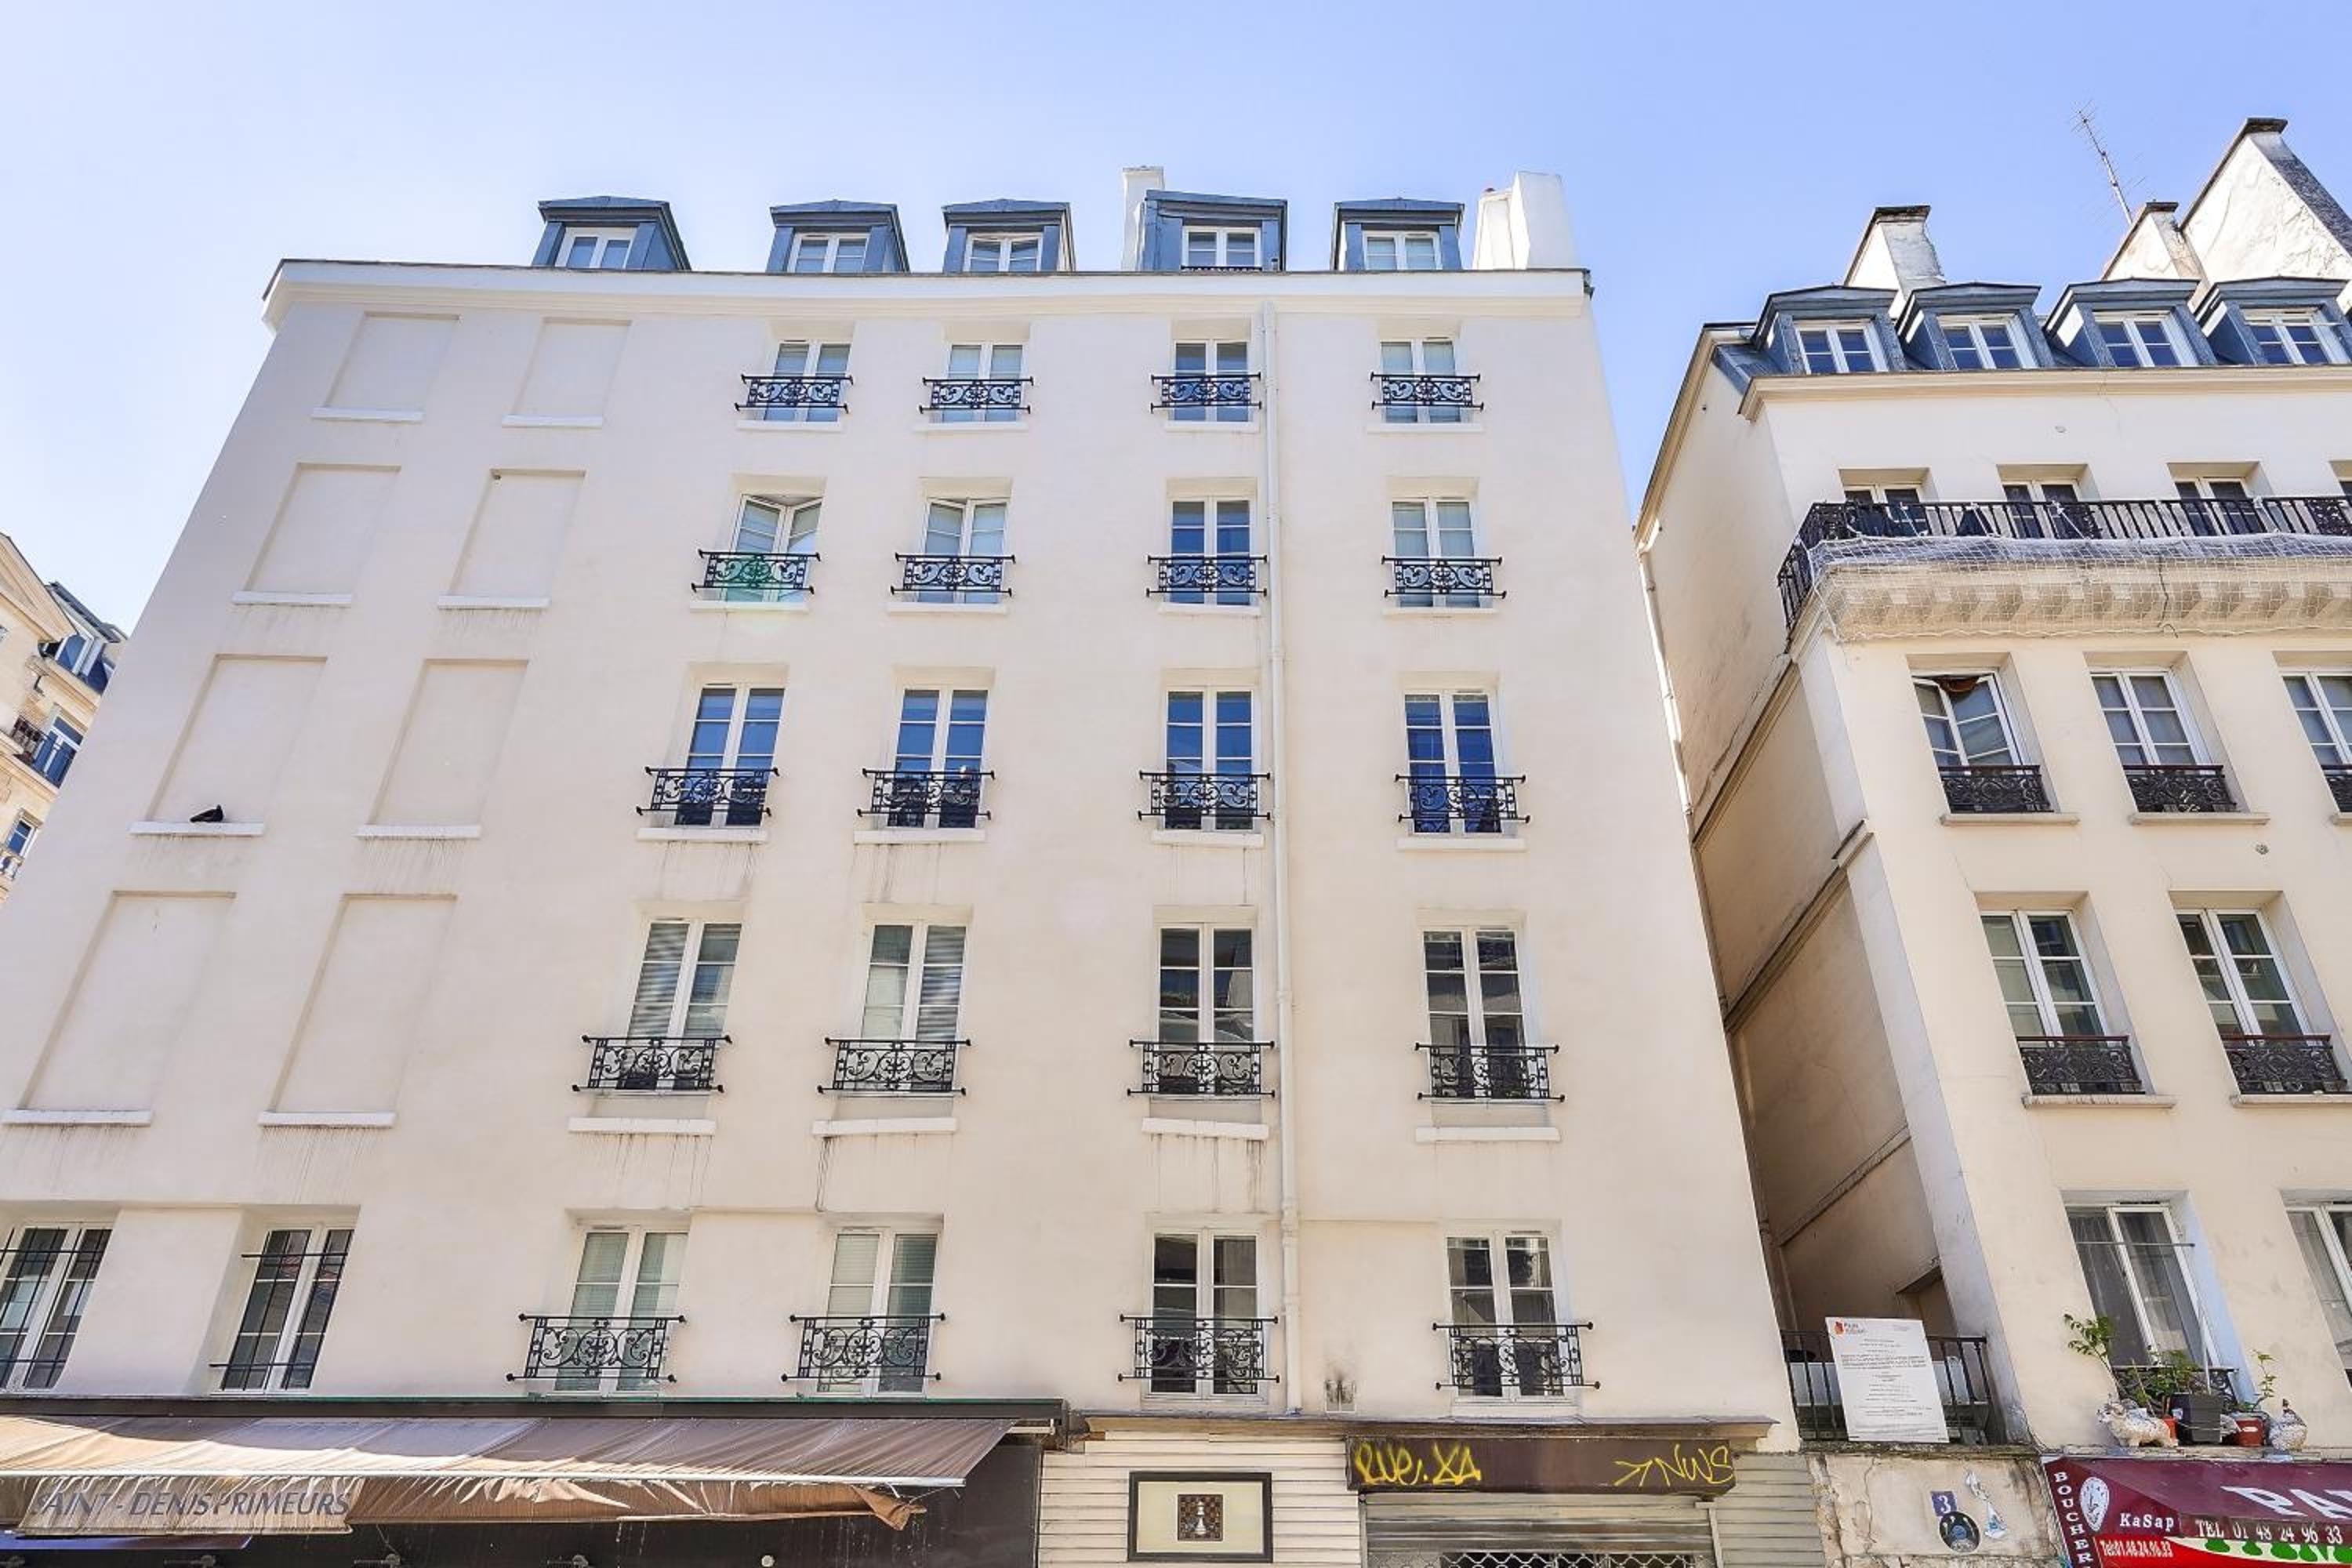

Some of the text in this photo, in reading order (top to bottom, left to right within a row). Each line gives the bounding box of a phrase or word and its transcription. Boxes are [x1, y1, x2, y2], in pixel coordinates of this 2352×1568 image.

[129, 1490, 212, 1515] DENIS
[213, 1492, 350, 1515] PRIMEURS
[1938, 1495, 1951, 1514] 3
[2053, 1472, 2094, 1568] BOUCHER
[2119, 1512, 2175, 1532] KaSap
[2195, 1519, 2224, 1539] TEL
[2256, 1523, 2272, 1541] 48
[2279, 1525, 2295, 1542] 24
[2301, 1523, 2318, 1543] 96
[2325, 1525, 2343, 1544] 33
